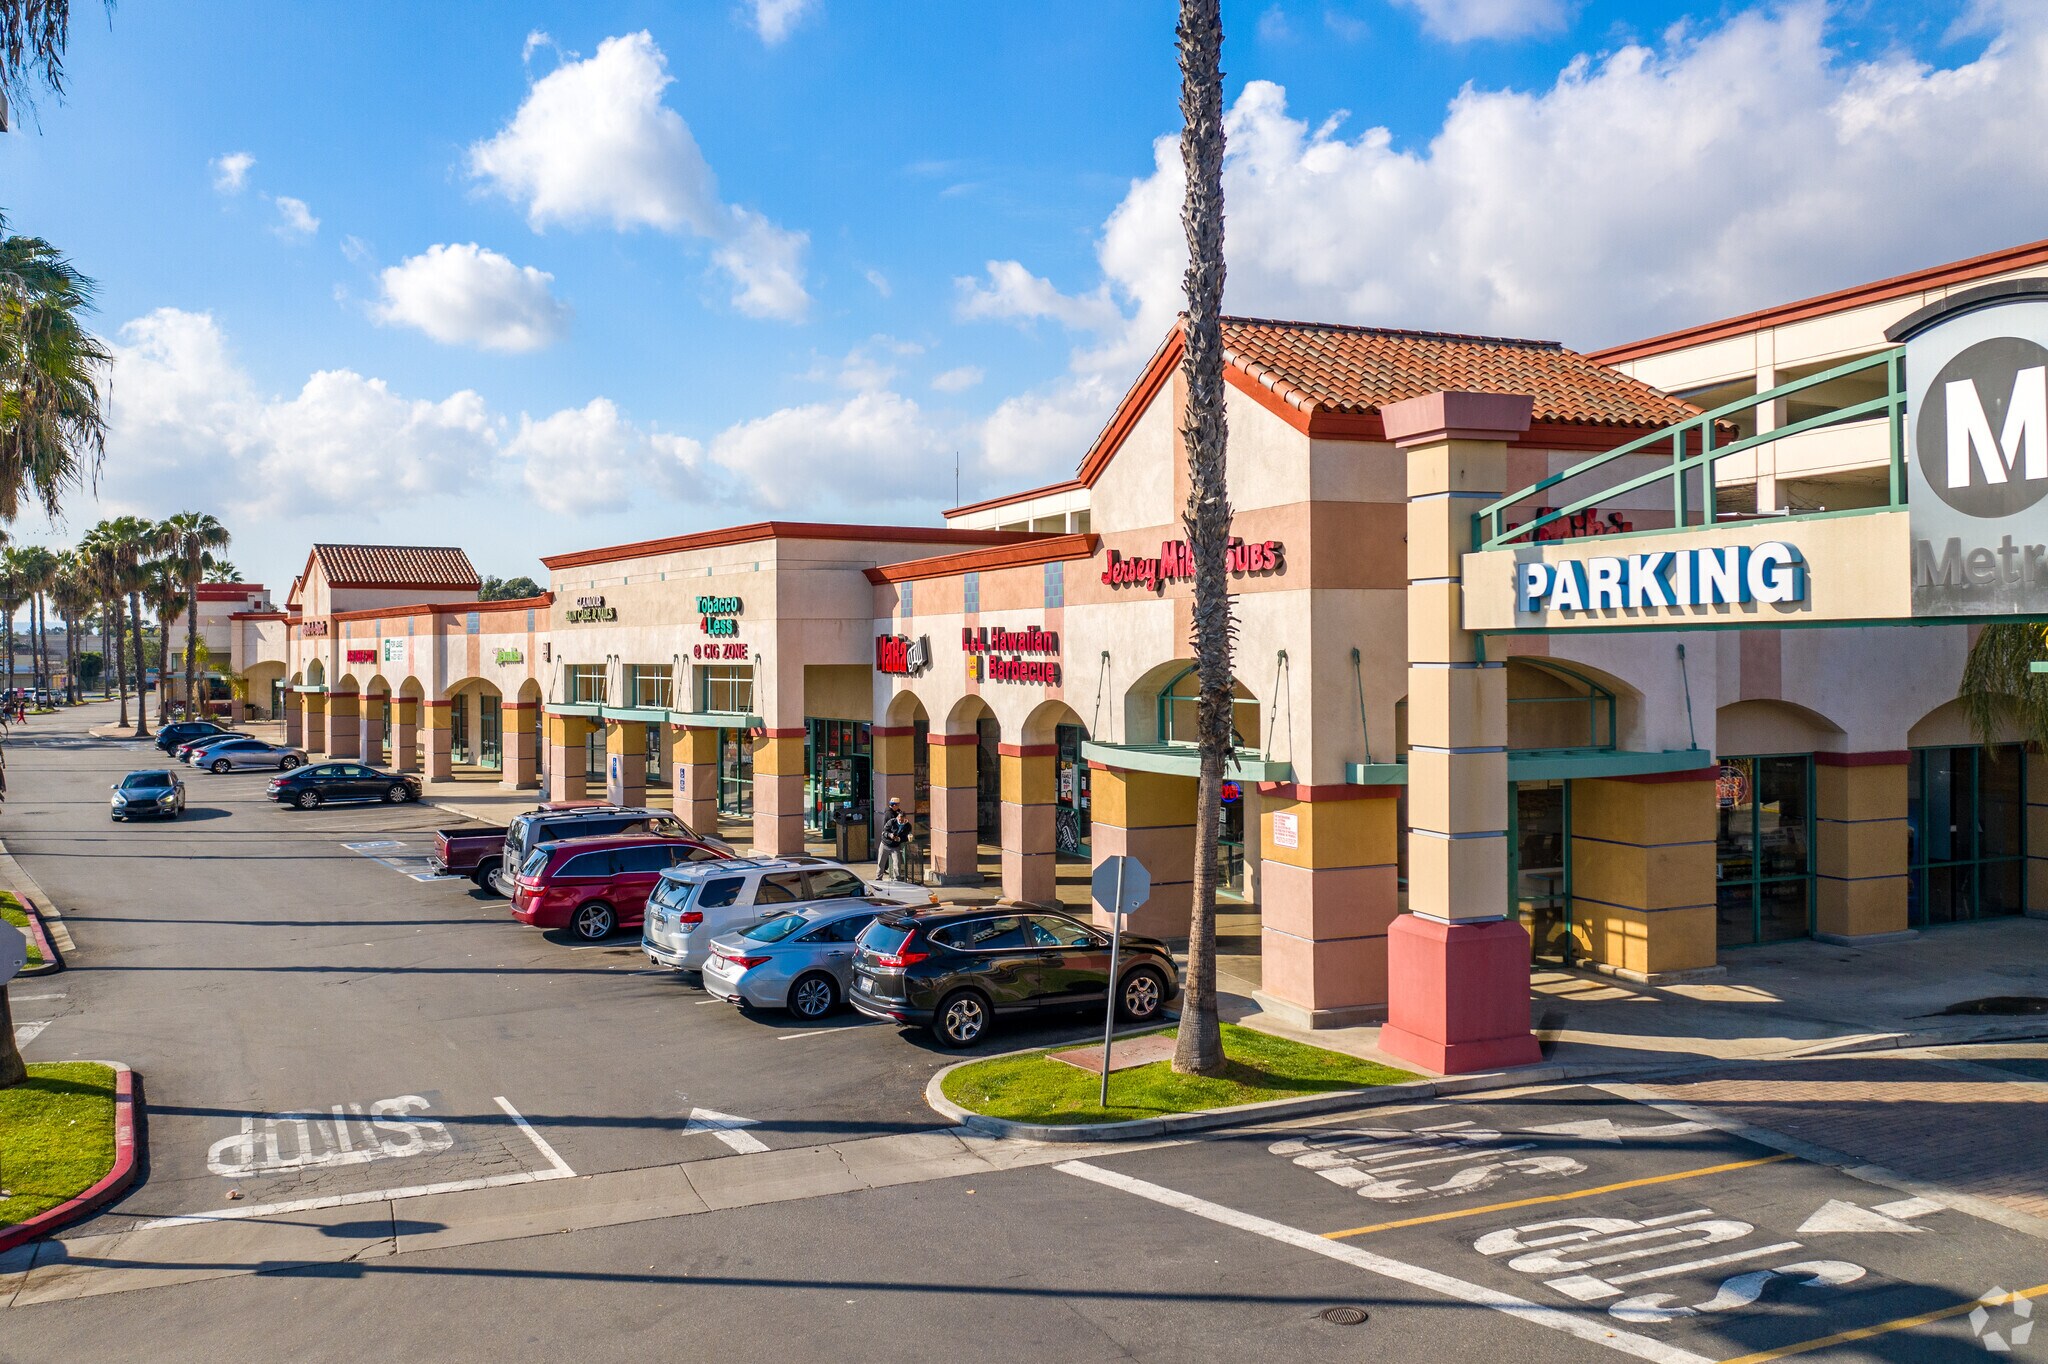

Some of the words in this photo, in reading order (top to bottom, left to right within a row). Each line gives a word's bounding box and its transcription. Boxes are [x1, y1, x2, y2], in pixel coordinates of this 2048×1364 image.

[1945, 365, 2048, 489] M
[1101, 549, 1158, 591] Jersey
[1518, 541, 1804, 612] PARKING
[695, 596, 738, 614] Tobacco
[693, 643, 702, 660] @
[703, 643, 720, 660] CIG
[722, 643, 748, 660] ZONE
[990, 625, 1053, 652] Hawaiian
[988, 655, 1056, 684] Barbecue
[1473, 1208, 1868, 1324] STOP
